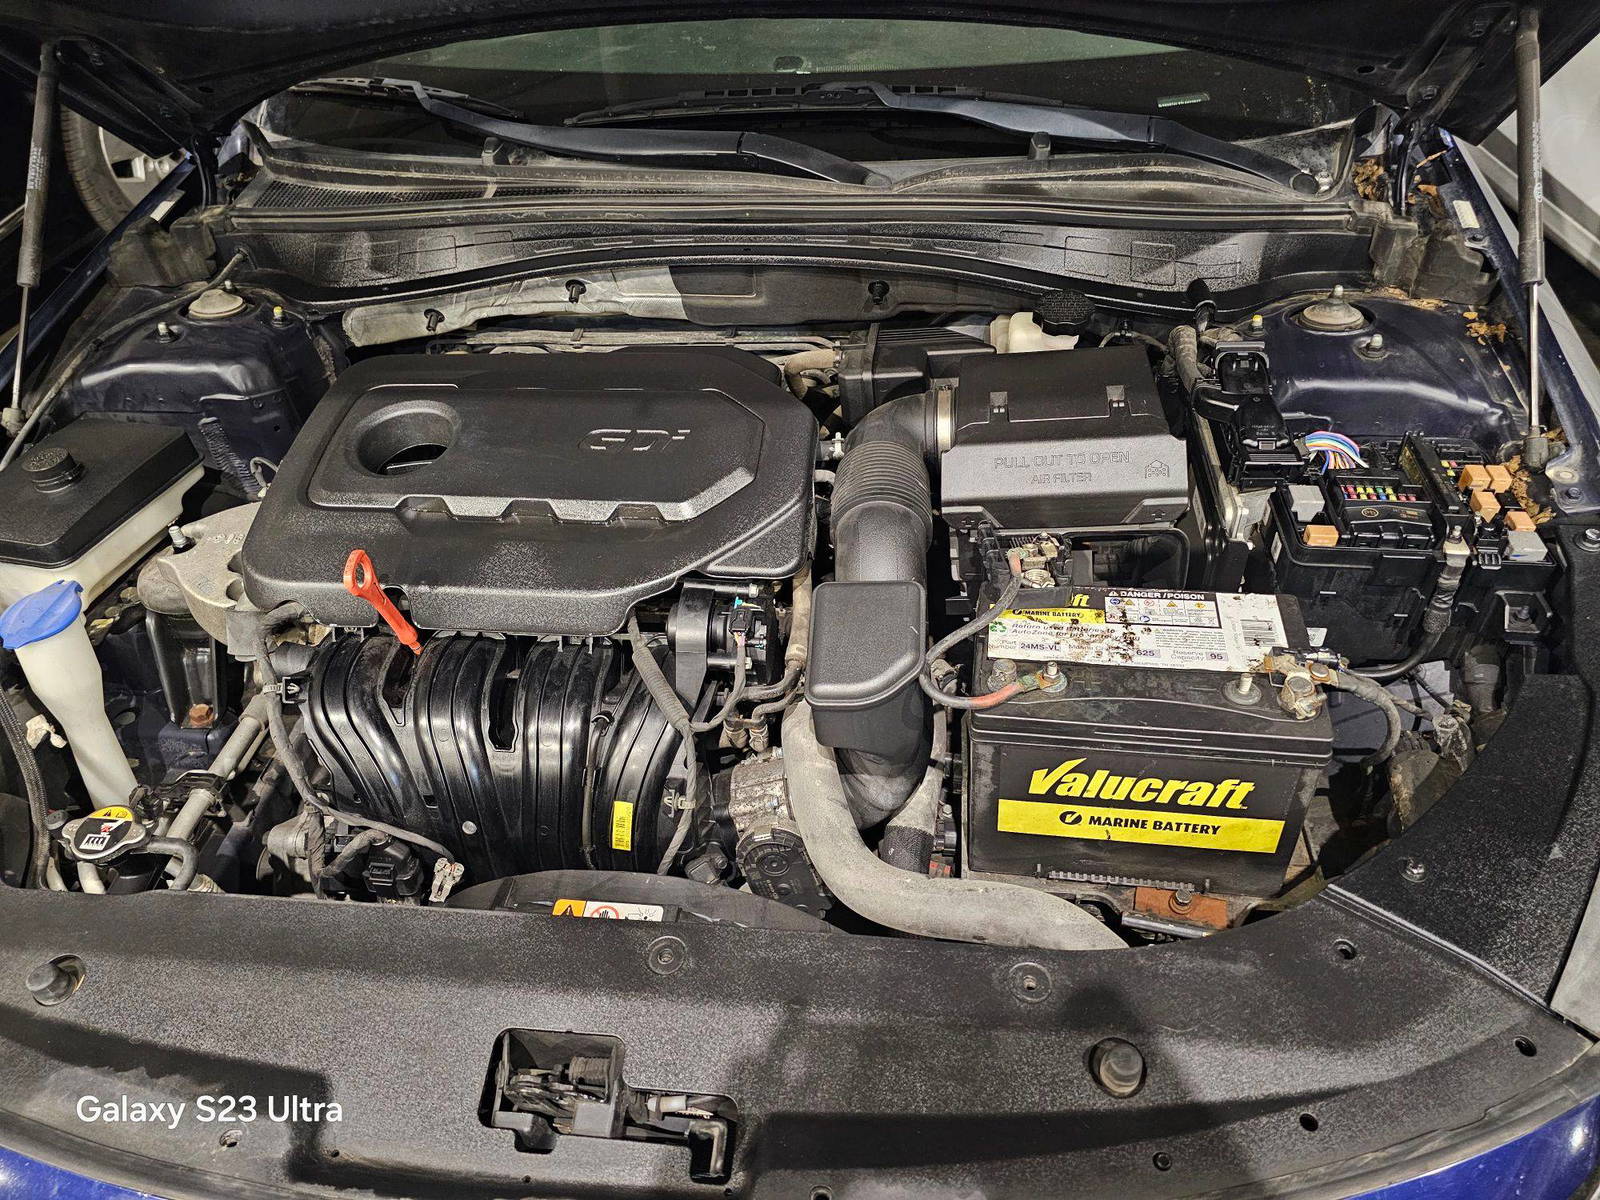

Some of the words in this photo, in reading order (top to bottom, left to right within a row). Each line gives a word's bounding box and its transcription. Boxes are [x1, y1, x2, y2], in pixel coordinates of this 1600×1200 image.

[993, 456, 1030, 469] PULL
[1033, 454, 1063, 467] OUT
[1067, 452, 1086, 465] TO
[1090, 450, 1130, 464] OPEN
[1031, 474, 1050, 484] AIR
[1053, 472, 1092, 483] FILTER
[1020, 642, 1061, 651] 24MS-VL
[1136, 649, 1155, 657] 625
[1210, 653, 1223, 661] 95
[1028, 757, 1255, 809] Valucraft
[1088, 815, 1148, 830] MARINE
[1152, 821, 1221, 836] BATTERY
